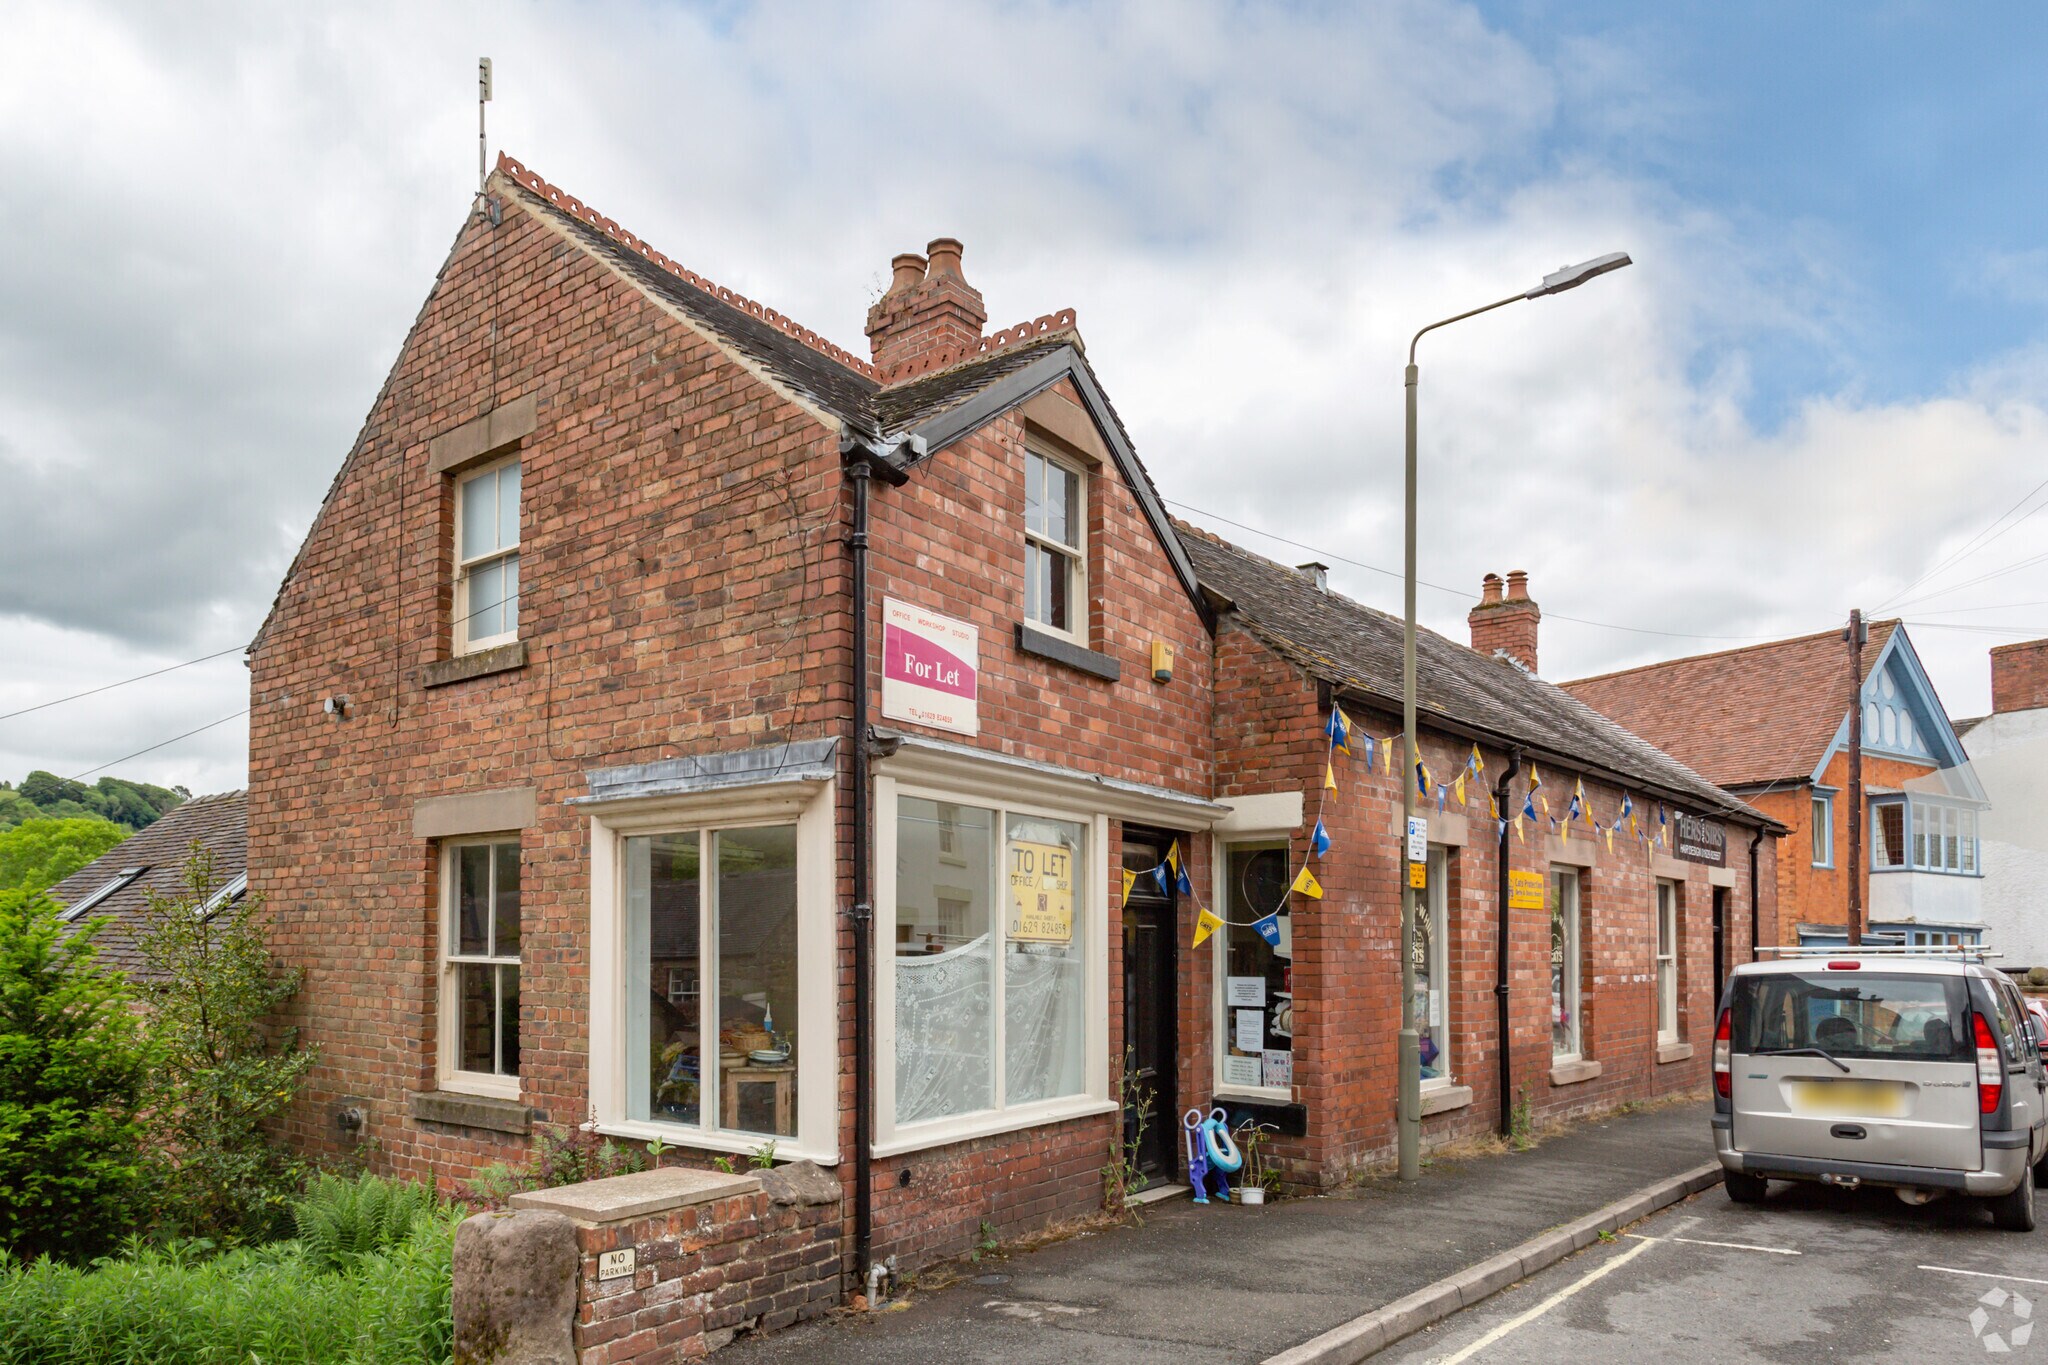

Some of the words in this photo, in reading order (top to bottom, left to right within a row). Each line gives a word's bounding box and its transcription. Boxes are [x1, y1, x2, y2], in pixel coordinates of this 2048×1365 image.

[892, 609, 911, 622] OFFICE
[917, 618, 946, 632] WORKSHOP
[952, 629, 970, 641] STUDIO
[904, 652, 932, 679] For
[935, 661, 960, 687] Let
[1679, 817, 1702, 843] HERS
[1705, 824, 1723, 847] SIRS
[1012, 848, 1034, 874] TO
[1042, 852, 1067, 877] LET
[1010, 875, 1033, 887] OFFICE
[1012, 920, 1038, 933] 01629
[1041, 922, 1067, 935] 824859
[1199, 921, 1213, 932] CATS
[611, 1252, 625, 1264] NO
[601, 1264, 632, 1277] PARKING
